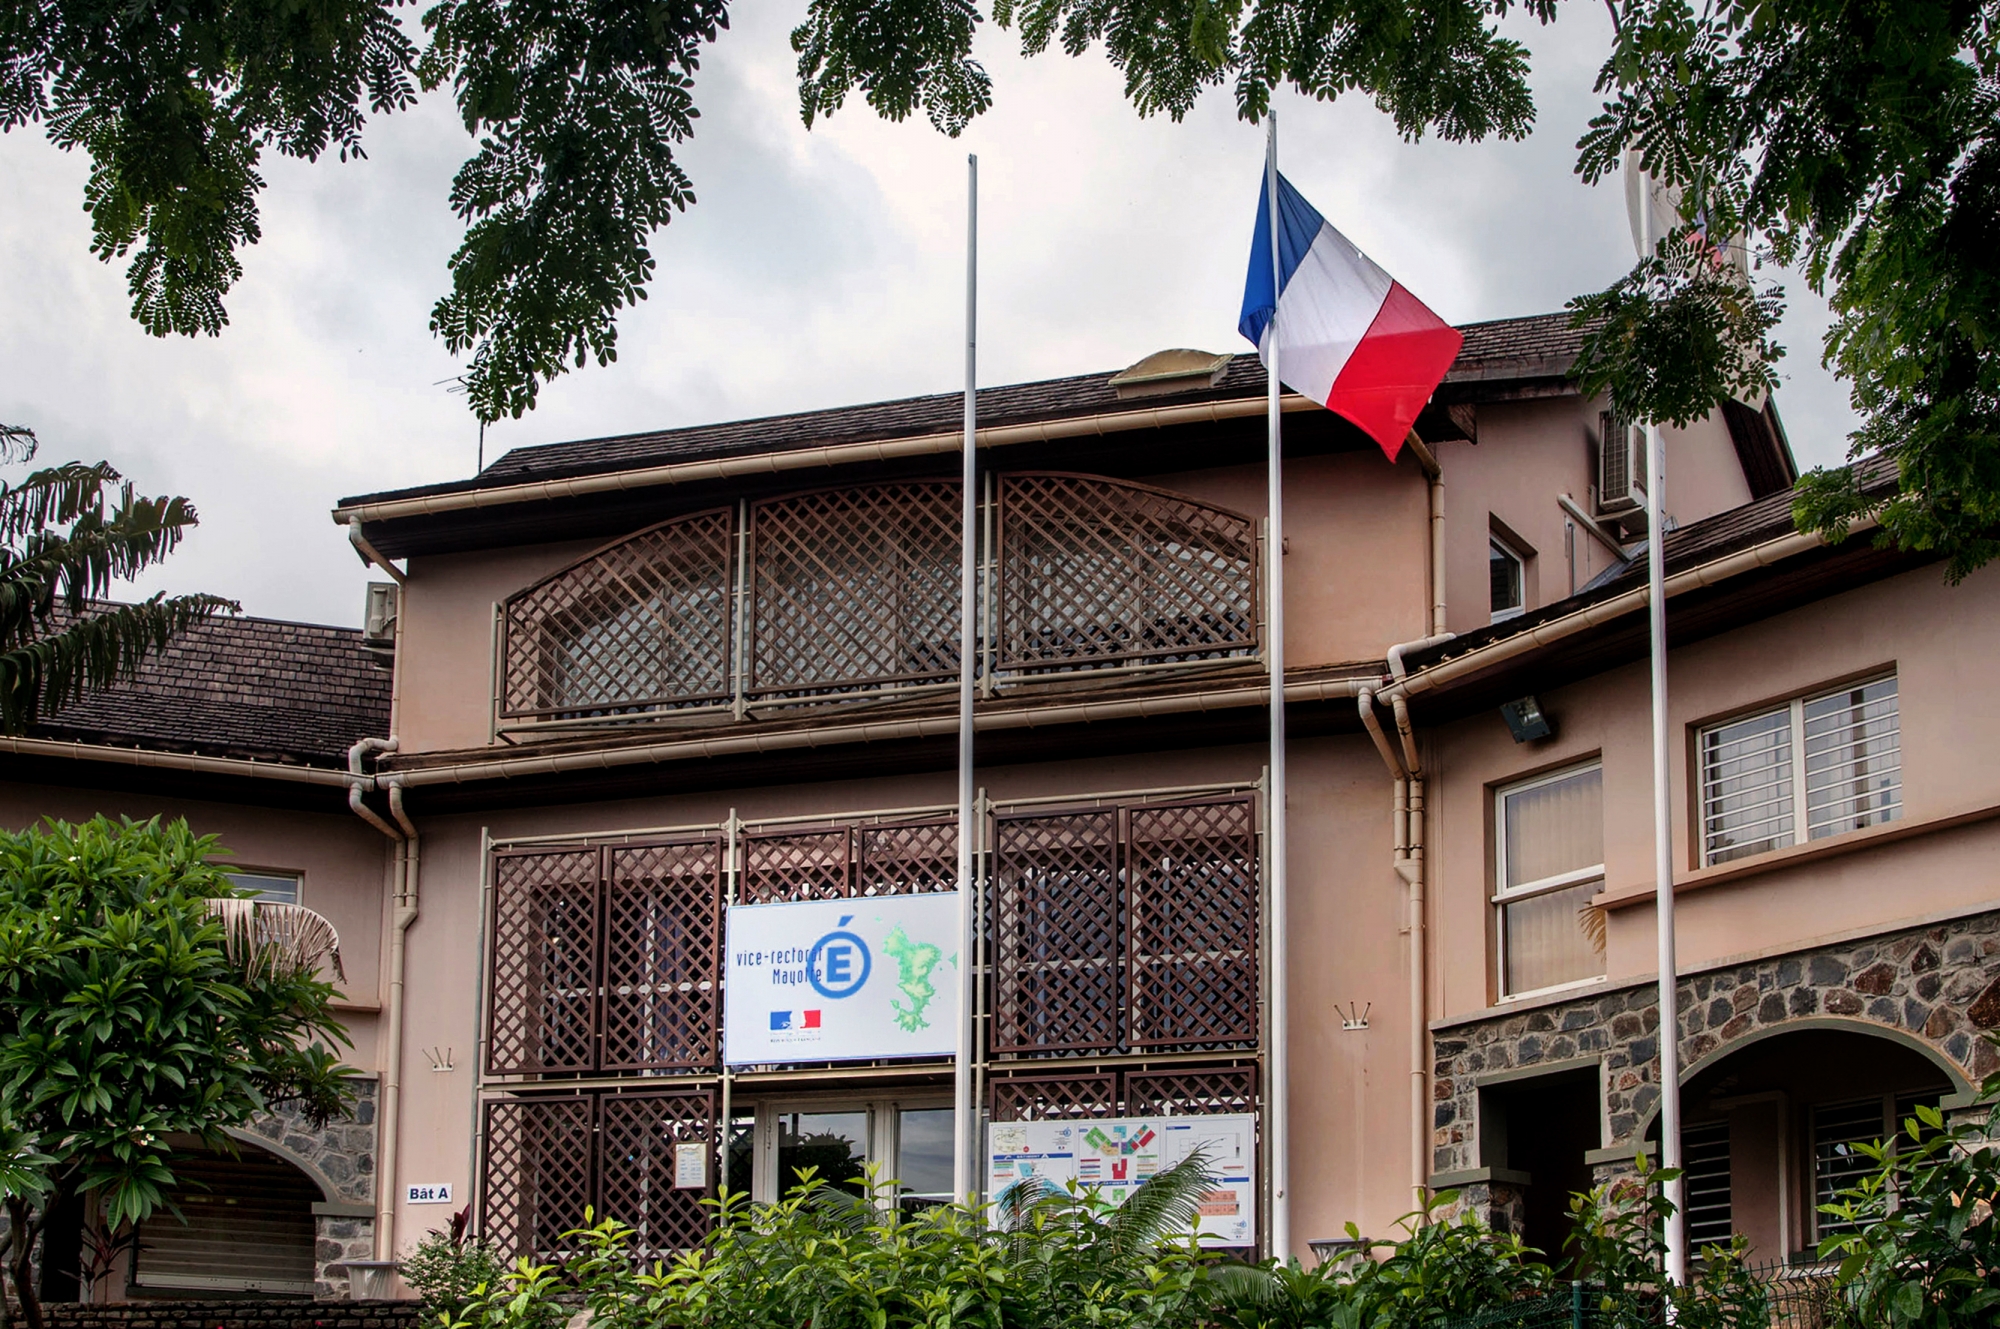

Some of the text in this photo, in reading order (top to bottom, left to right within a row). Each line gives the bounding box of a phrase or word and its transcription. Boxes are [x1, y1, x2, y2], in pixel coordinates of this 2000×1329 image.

[773, 967, 822, 986] Mayotte
[410, 1187, 448, 1200] Bât A
